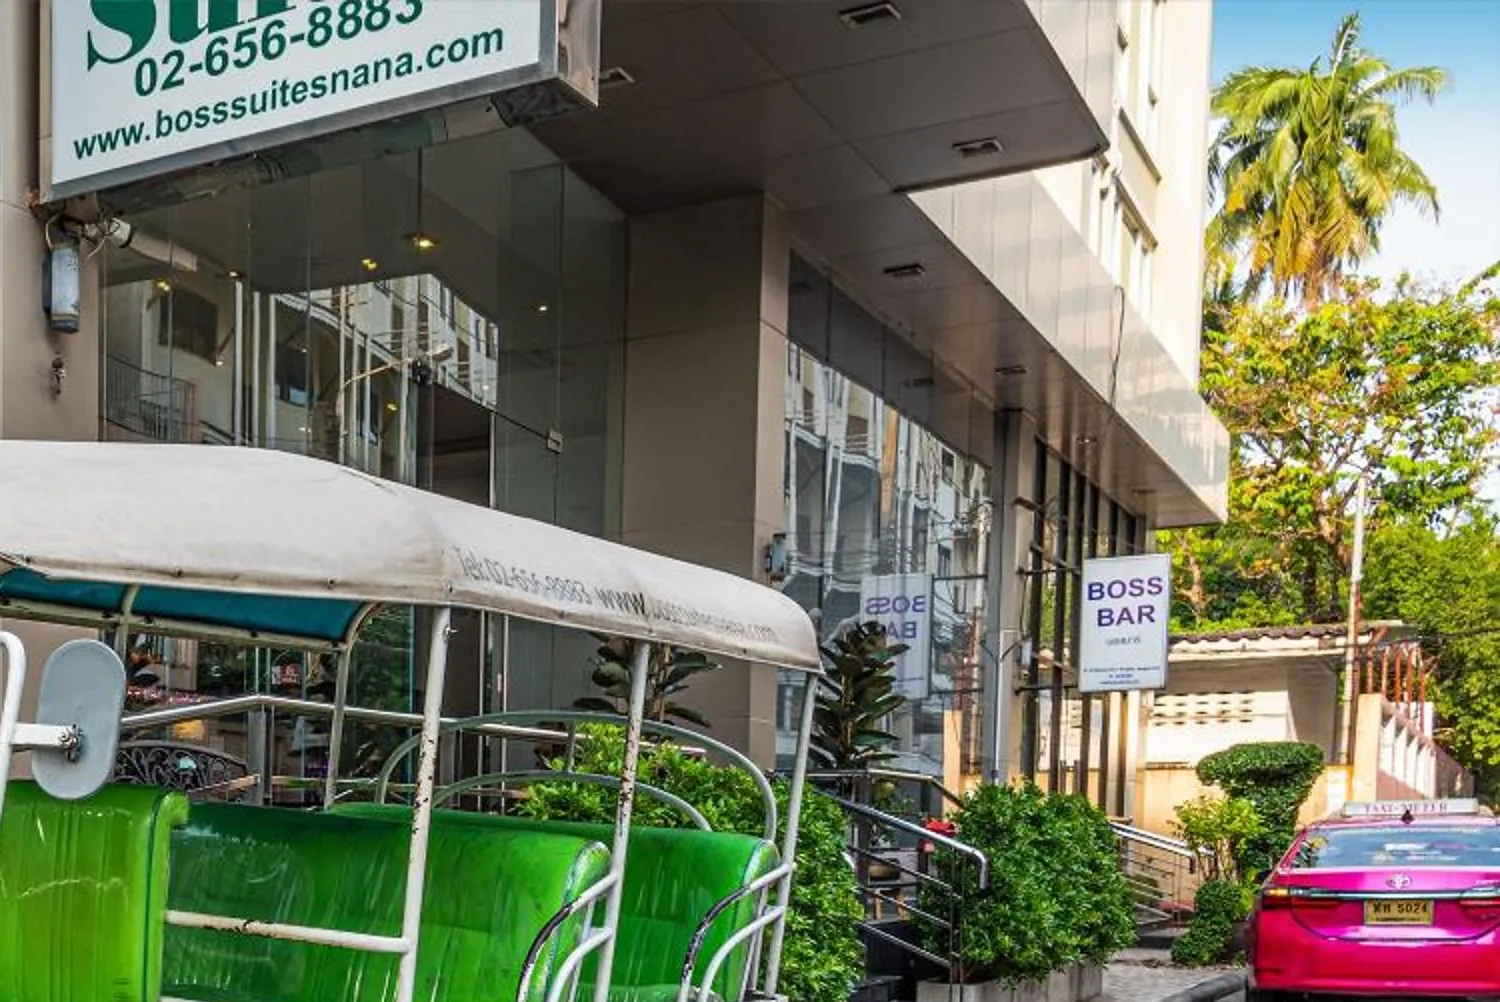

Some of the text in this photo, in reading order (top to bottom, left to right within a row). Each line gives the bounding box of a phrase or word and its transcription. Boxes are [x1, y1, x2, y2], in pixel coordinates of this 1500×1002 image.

[73, 26, 504, 161] www.bosssuitesnana.com
[1087, 576, 1164, 601] BOSS
[1096, 604, 1157, 628] BAR
